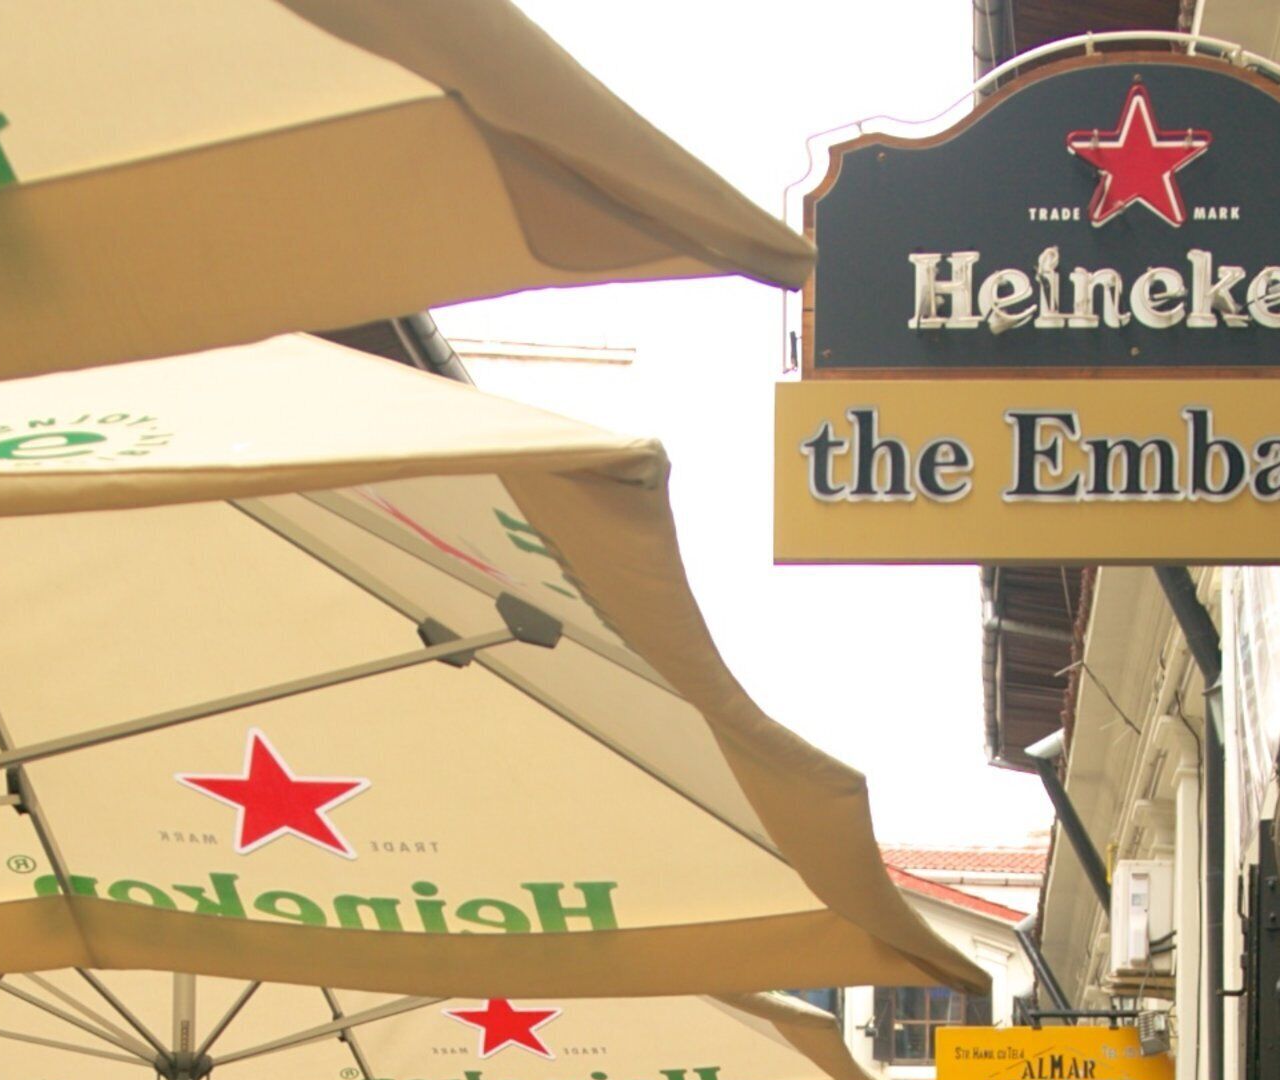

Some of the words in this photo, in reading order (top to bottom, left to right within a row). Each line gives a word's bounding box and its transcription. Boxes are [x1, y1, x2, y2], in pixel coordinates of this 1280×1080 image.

[1027, 205, 1082, 222] TRADE
[1191, 204, 1241, 221] MARK
[800, 406, 974, 504] the
[1021, 1054, 1096, 1080] ALMAR
